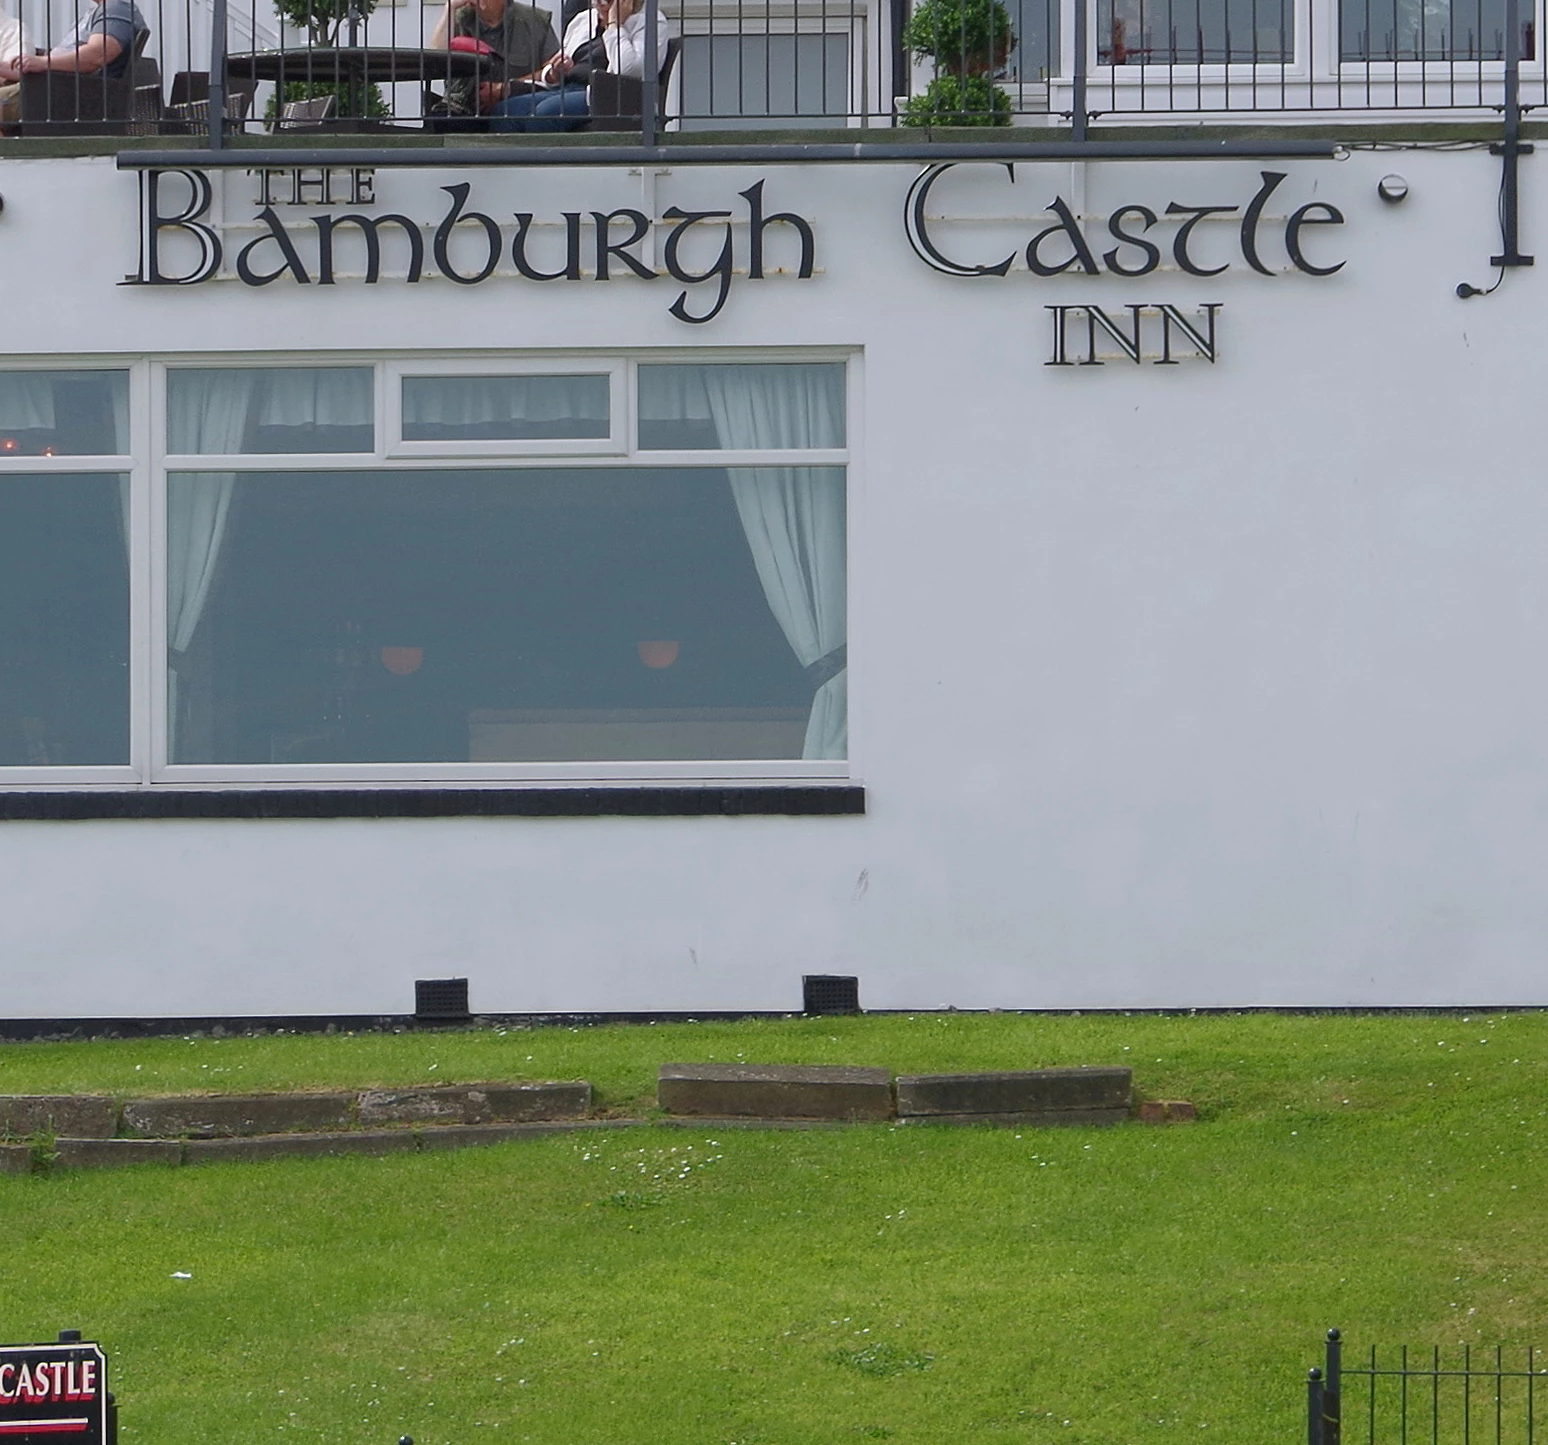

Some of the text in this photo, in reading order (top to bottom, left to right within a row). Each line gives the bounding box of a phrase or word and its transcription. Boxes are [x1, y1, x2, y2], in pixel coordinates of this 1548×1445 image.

[246, 166, 376, 206] THE
[117, 163, 1348, 324] Bamburgh Castle
[1043, 303, 1223, 367] INN
